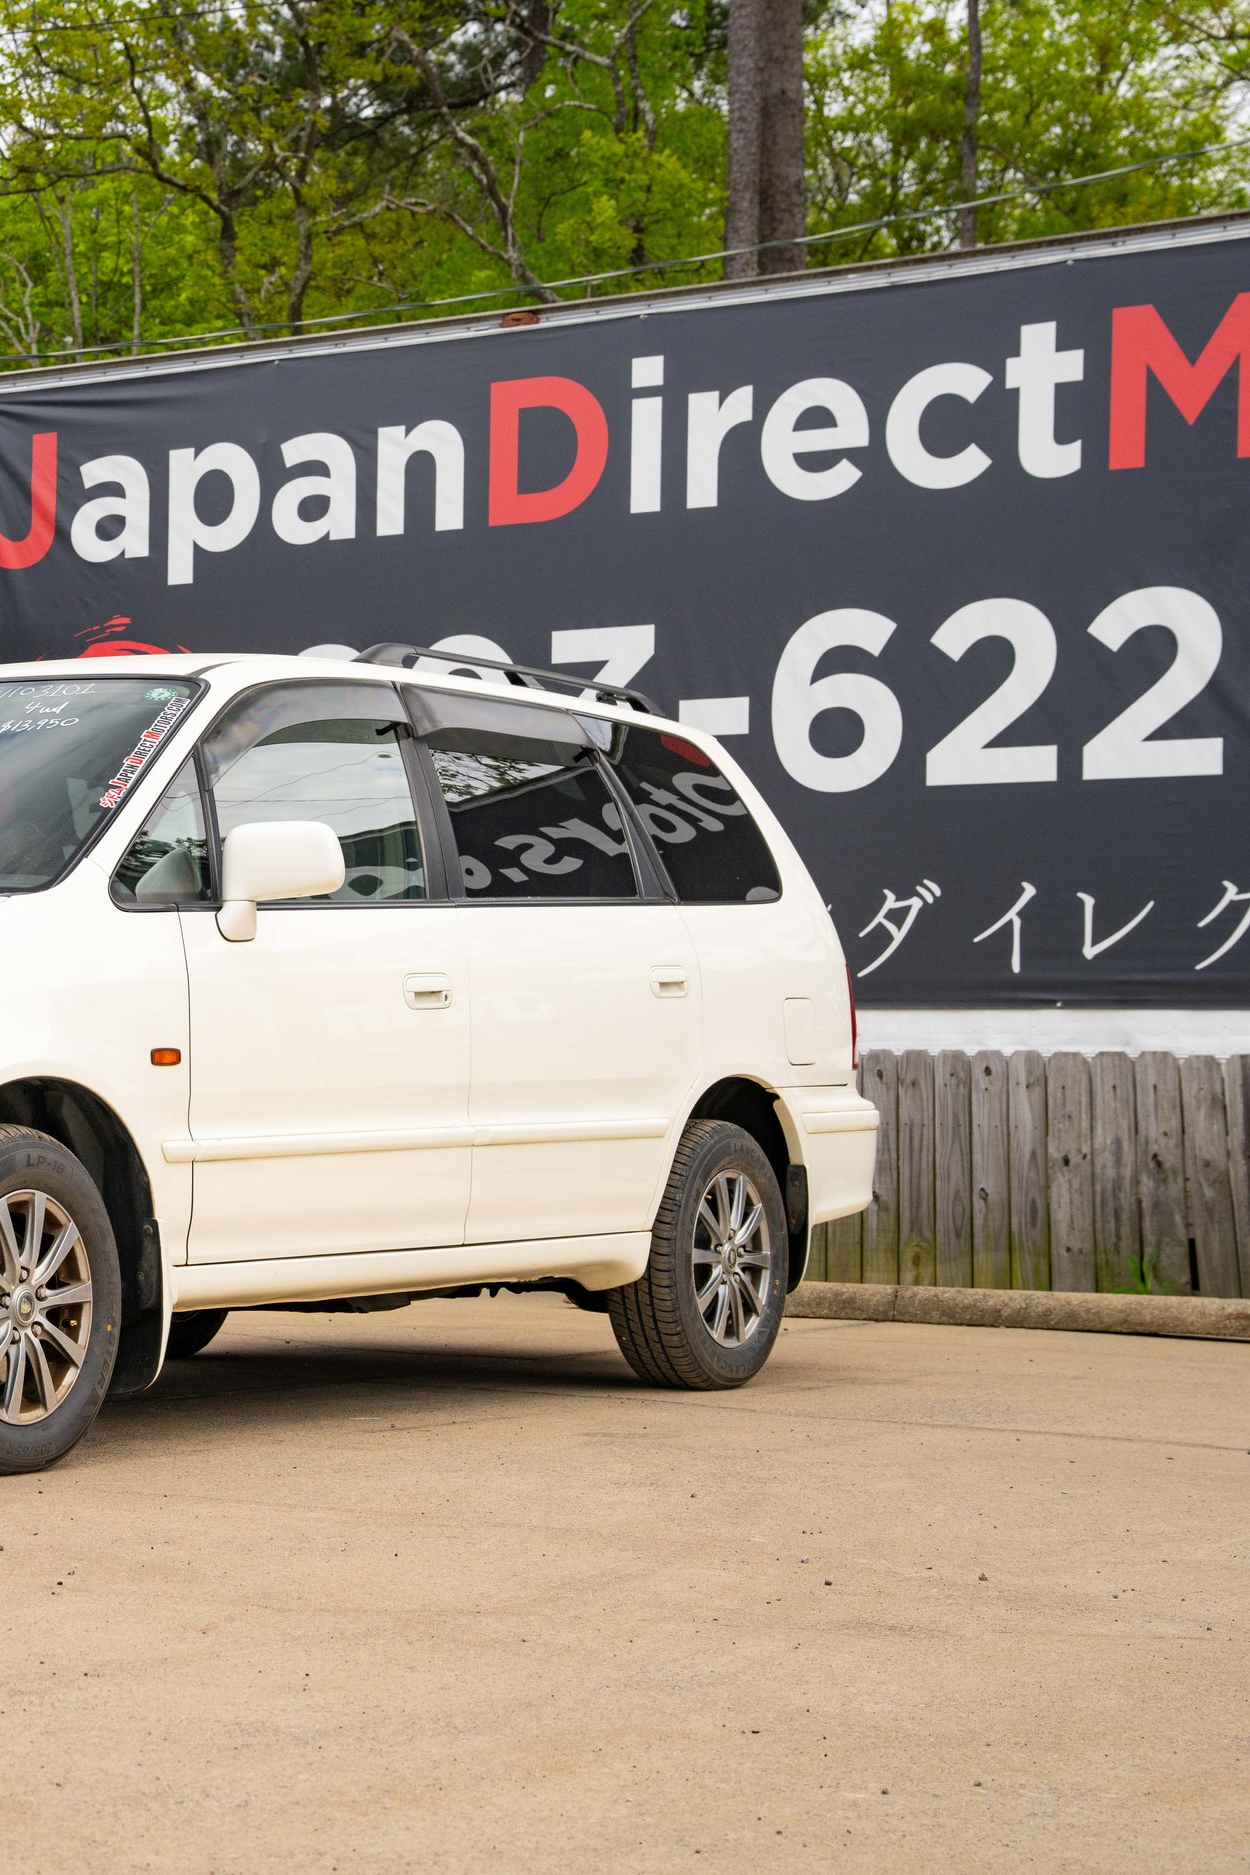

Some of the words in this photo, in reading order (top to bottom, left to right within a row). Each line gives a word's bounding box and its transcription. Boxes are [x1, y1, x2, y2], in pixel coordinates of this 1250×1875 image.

[297, 586, 1224, 793] -622
[827, 879, 1250, 977] ダイレク
